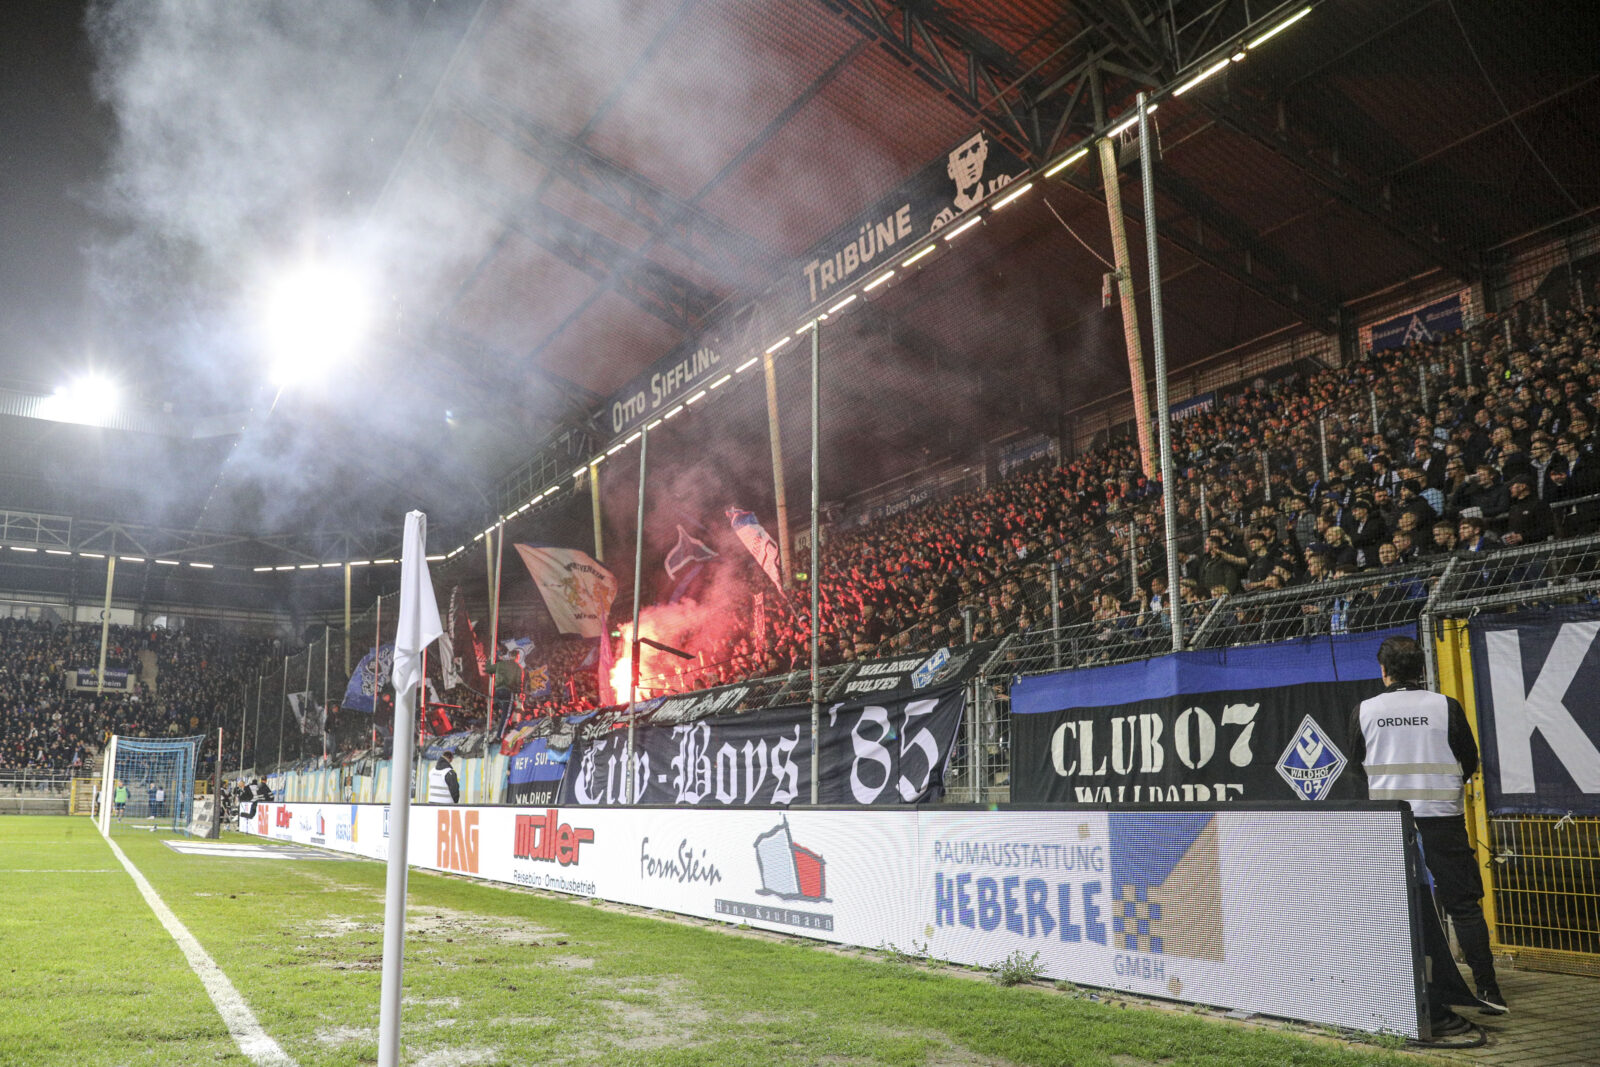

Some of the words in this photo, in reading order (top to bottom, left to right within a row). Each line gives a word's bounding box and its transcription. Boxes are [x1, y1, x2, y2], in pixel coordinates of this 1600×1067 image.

[804, 204, 912, 302] TRIBÜNE
[613, 401, 646, 433] OTTO
[856, 658, 925, 676] WALDHOF
[845, 676, 901, 694] WOLVES
[1377, 716, 1429, 728] ORDNER
[1051, 713, 1164, 777] CLUB
[1174, 703, 1260, 770] 07
[1290, 768, 1330, 780] WALDHOF
[1303, 779, 1323, 795] 07
[640, 836, 722, 886] FormStein
[934, 840, 1104, 872] RAUMAUSSTATTUNG
[513, 869, 542, 886] Reisebüro
[544, 873, 596, 895] Omnibusbetrieb
[715, 900, 747, 917] Hans
[755, 906, 832, 931] Kaufmann
[935, 872, 1108, 947] HEBERLE
[1114, 954, 1165, 981] GMBH
